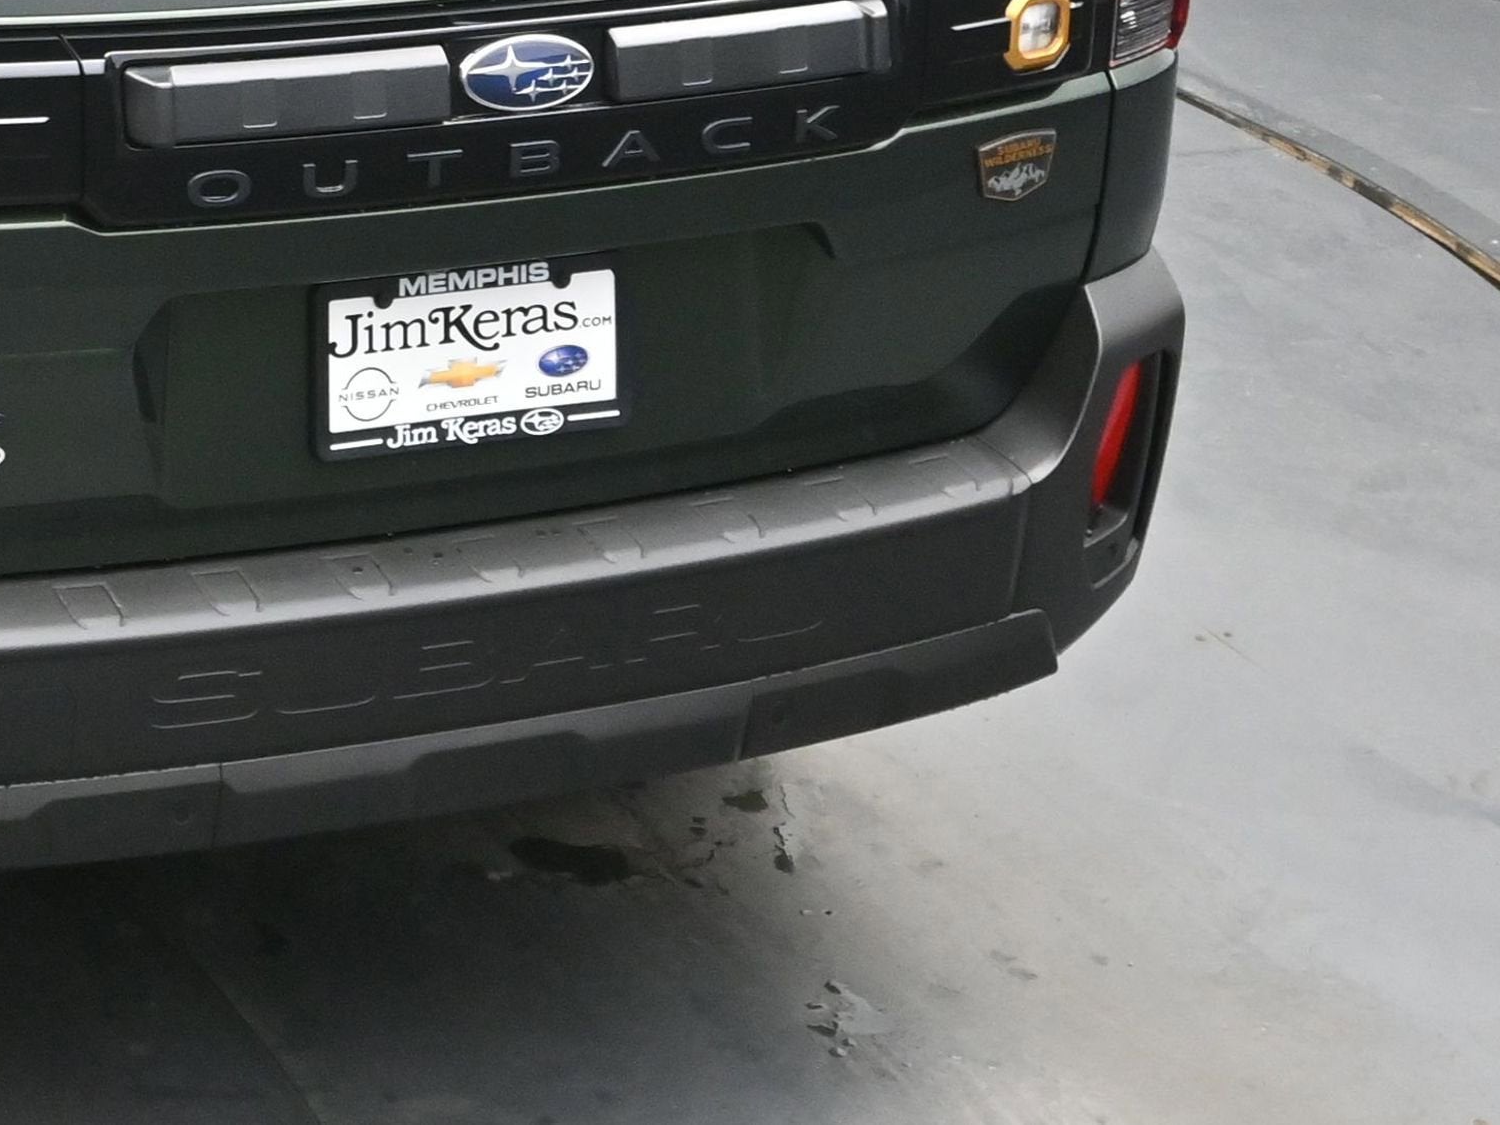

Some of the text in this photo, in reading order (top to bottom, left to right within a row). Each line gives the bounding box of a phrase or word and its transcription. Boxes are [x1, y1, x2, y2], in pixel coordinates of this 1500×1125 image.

[186, 104, 841, 208] OUTBACK
[399, 261, 550, 297] MEMPHIS
[338, 386, 399, 402] NISSAN
[524, 378, 602, 399] SUBARU
[426, 395, 499, 412] CHEVROLET
[386, 415, 517, 449] Jim Keras
